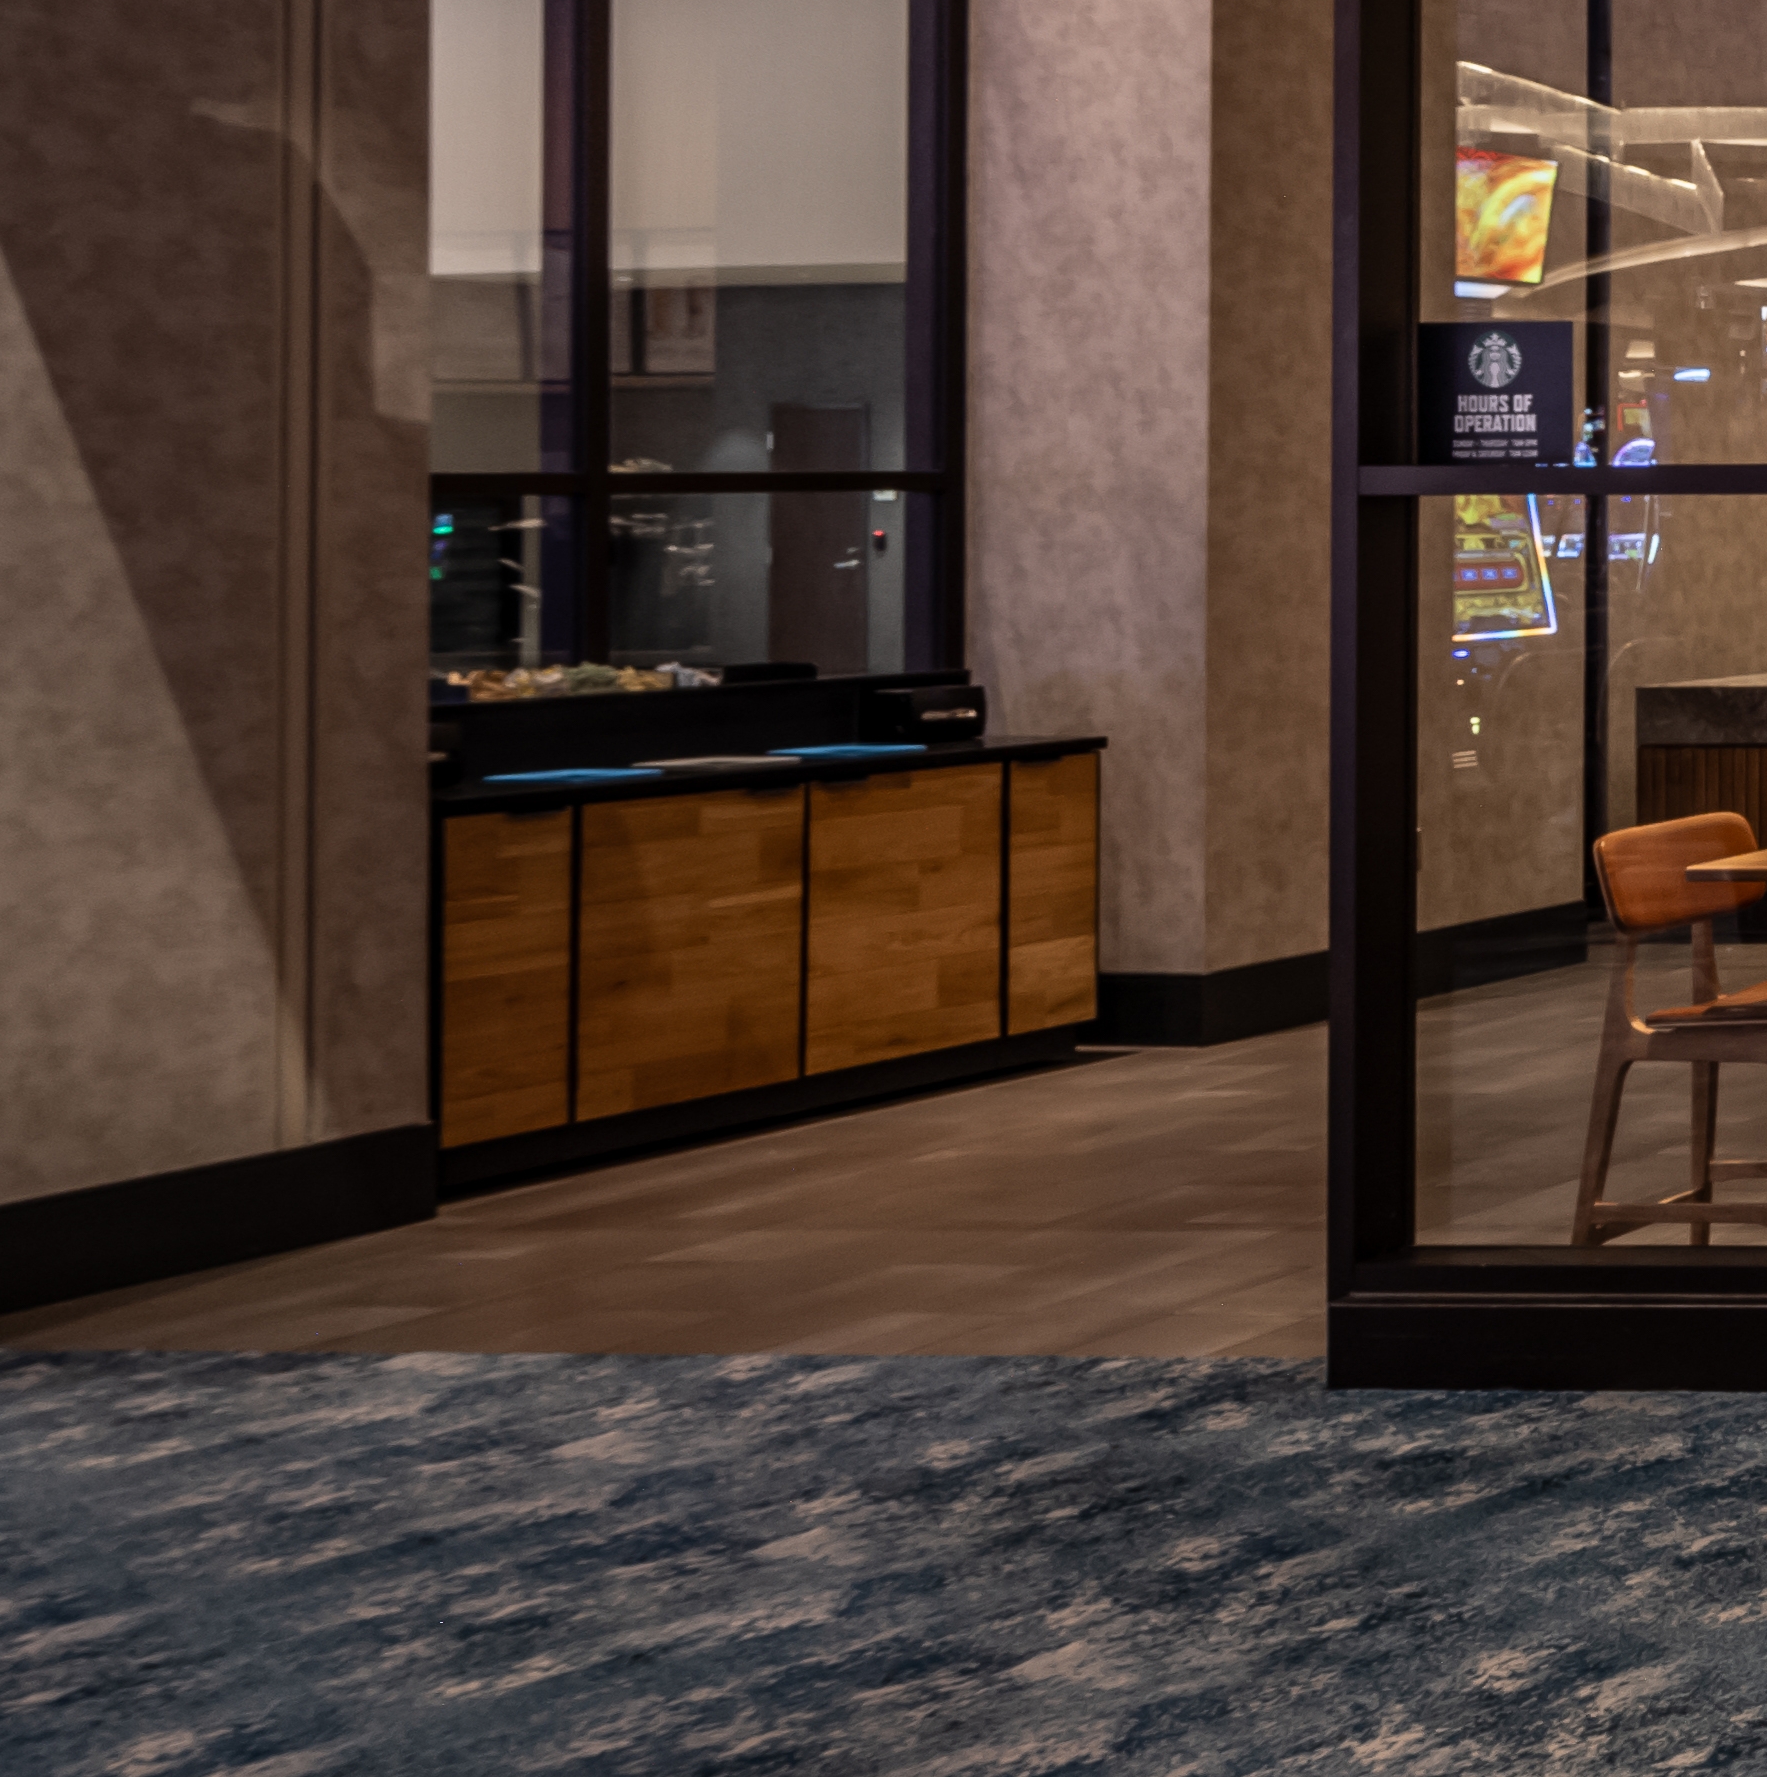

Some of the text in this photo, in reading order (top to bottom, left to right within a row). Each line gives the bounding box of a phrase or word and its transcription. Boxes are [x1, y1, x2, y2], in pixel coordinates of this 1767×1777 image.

[1457, 394, 1533, 413] HOURS OF
[1454, 414, 1537, 433] OPERATION
